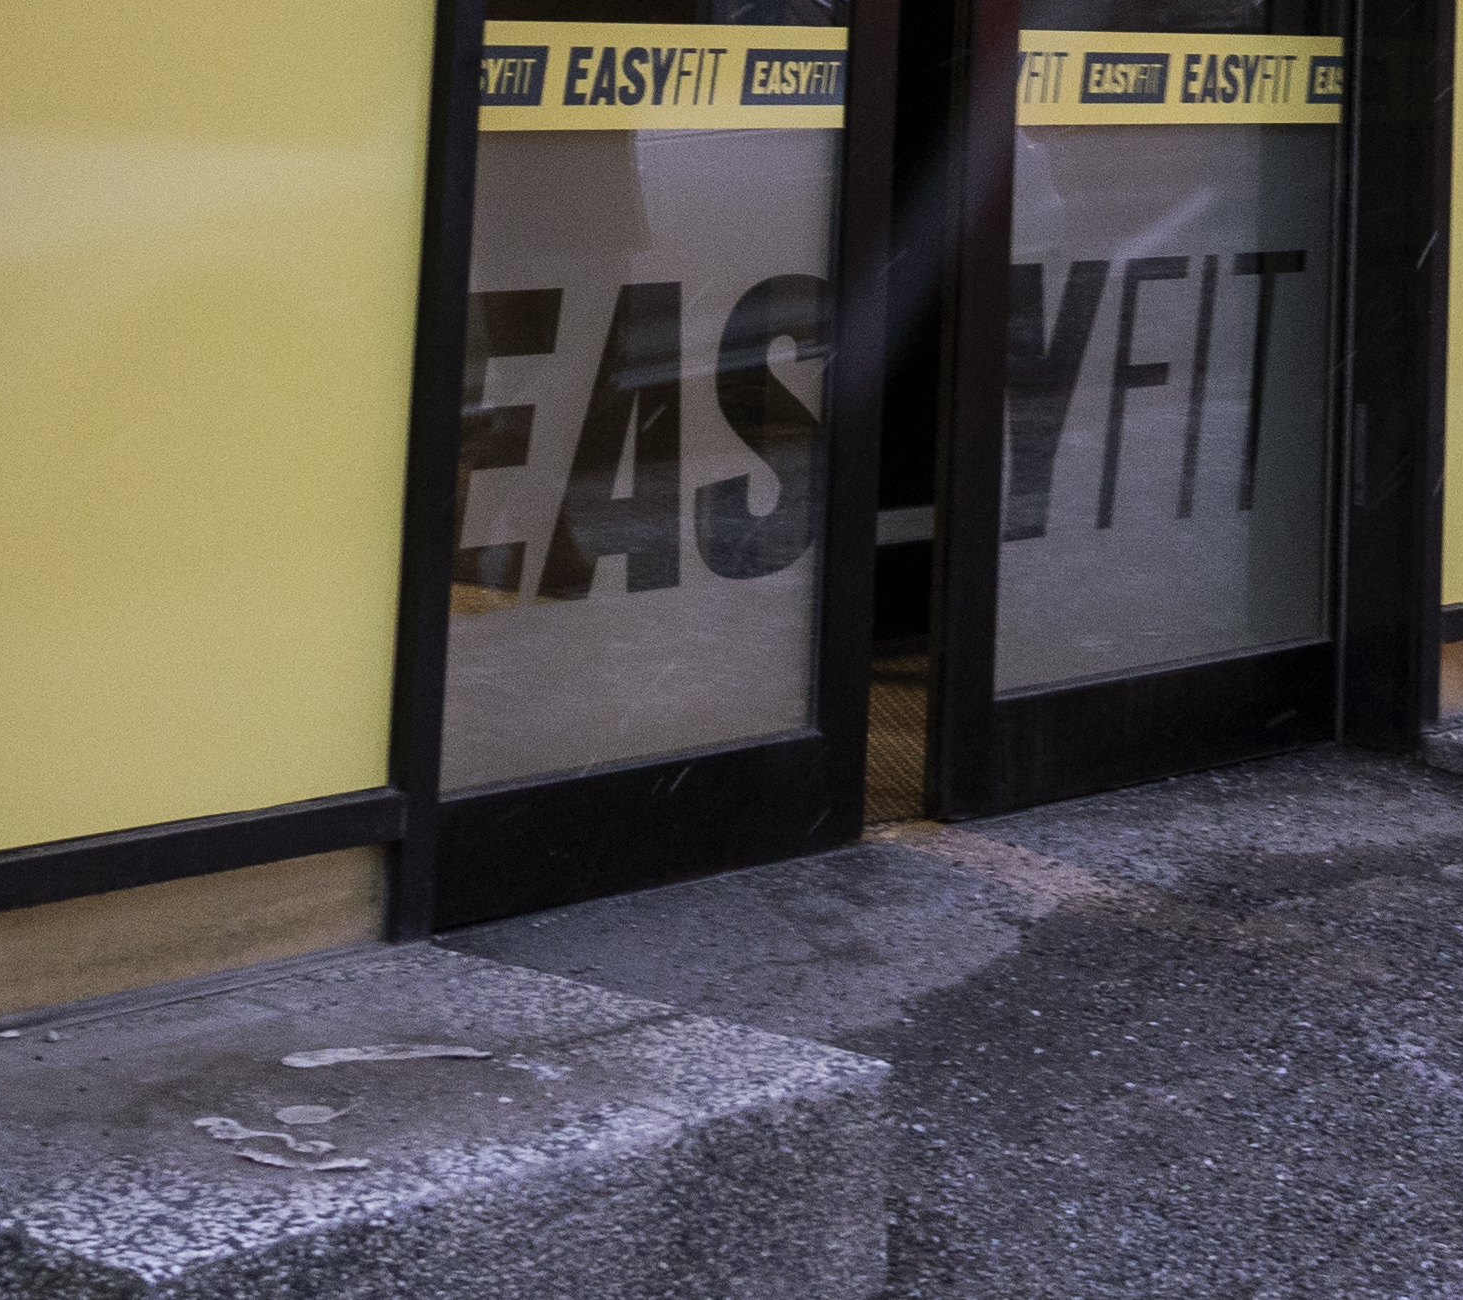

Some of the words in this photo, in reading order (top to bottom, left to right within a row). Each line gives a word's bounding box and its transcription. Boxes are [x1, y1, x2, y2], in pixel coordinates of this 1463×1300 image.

[563, 46, 727, 106] EASYFIT
[752, 60, 842, 96] EASYFIT
[1088, 63, 1163, 94] EASYFIT
[1181, 53, 1297, 104] EASYFIT
[456, 274, 831, 601] EAS
